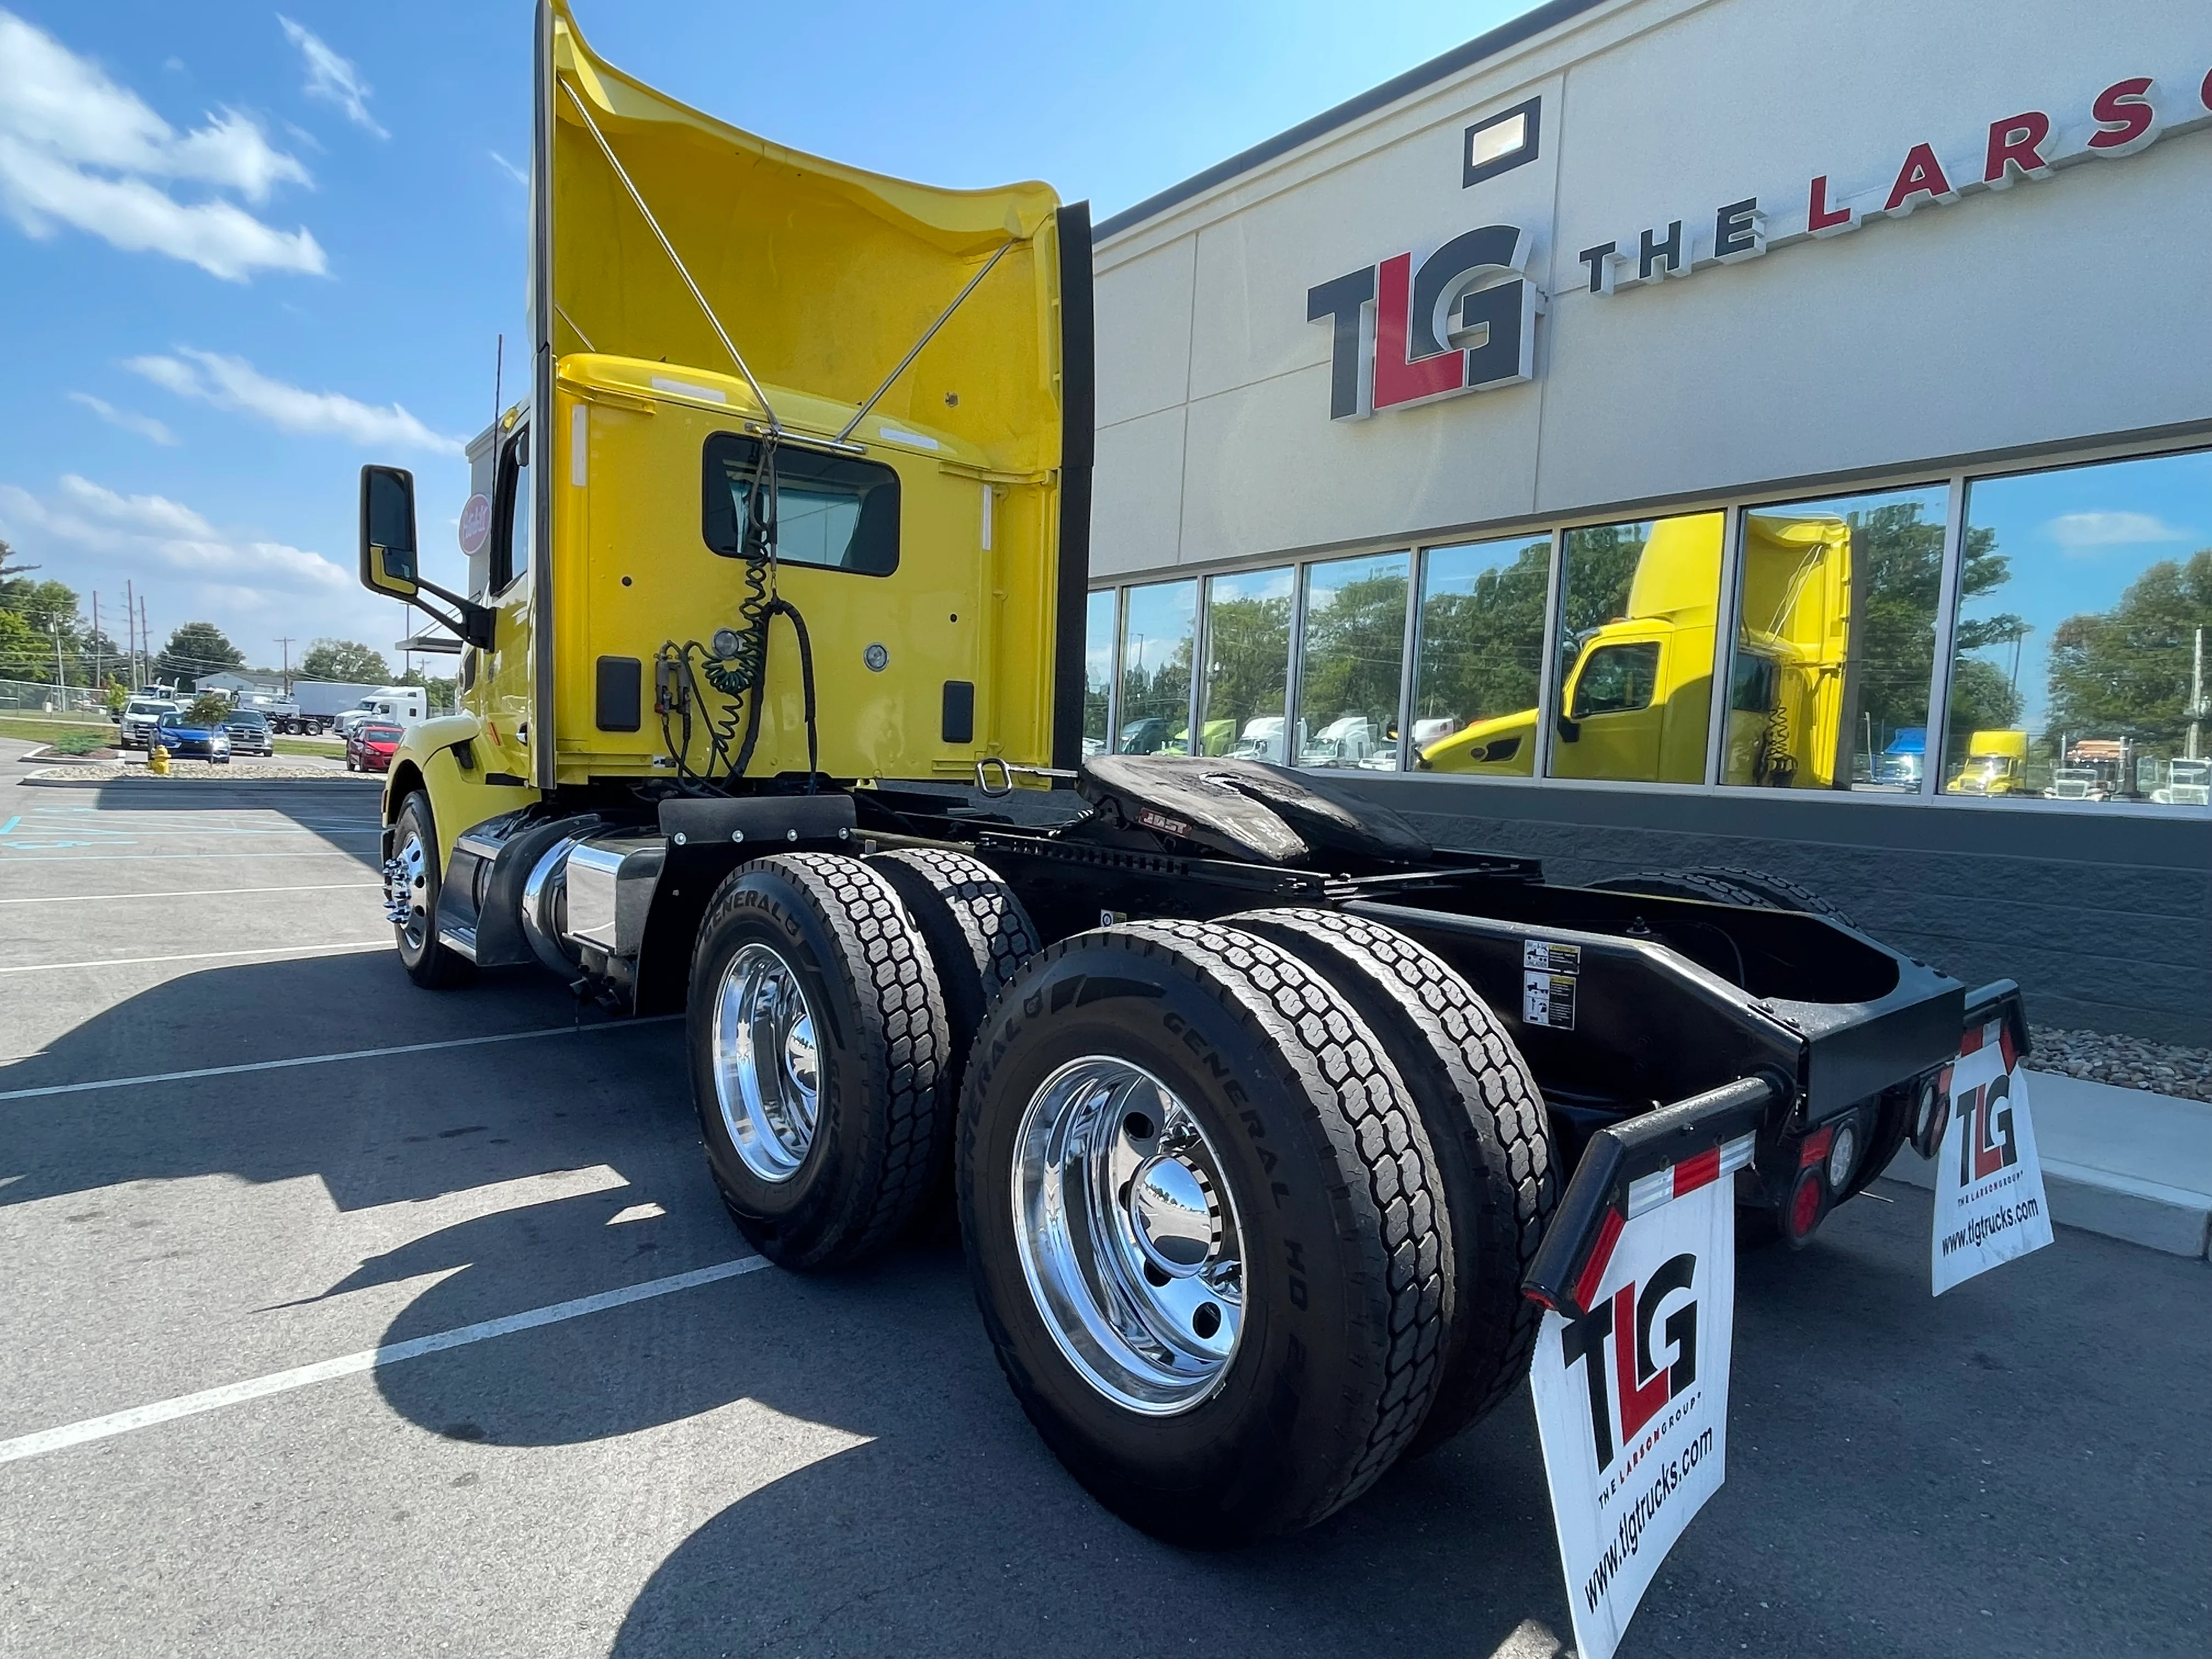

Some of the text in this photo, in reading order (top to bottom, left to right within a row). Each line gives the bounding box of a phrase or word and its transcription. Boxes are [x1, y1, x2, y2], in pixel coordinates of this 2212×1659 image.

[1578, 196, 1759, 295] THE
[1307, 224, 1531, 421] TLG
[1163, 1012, 1290, 1210] GENERAL
[1956, 1074, 2018, 1188] TLG
[1942, 1198, 2039, 1257] www.tlgtrucks.com
[1561, 1253, 1697, 1475] TLG
[1584, 1426, 1713, 1615] www.tlgtrucks.com
[1598, 1478, 1617, 1510] THE
